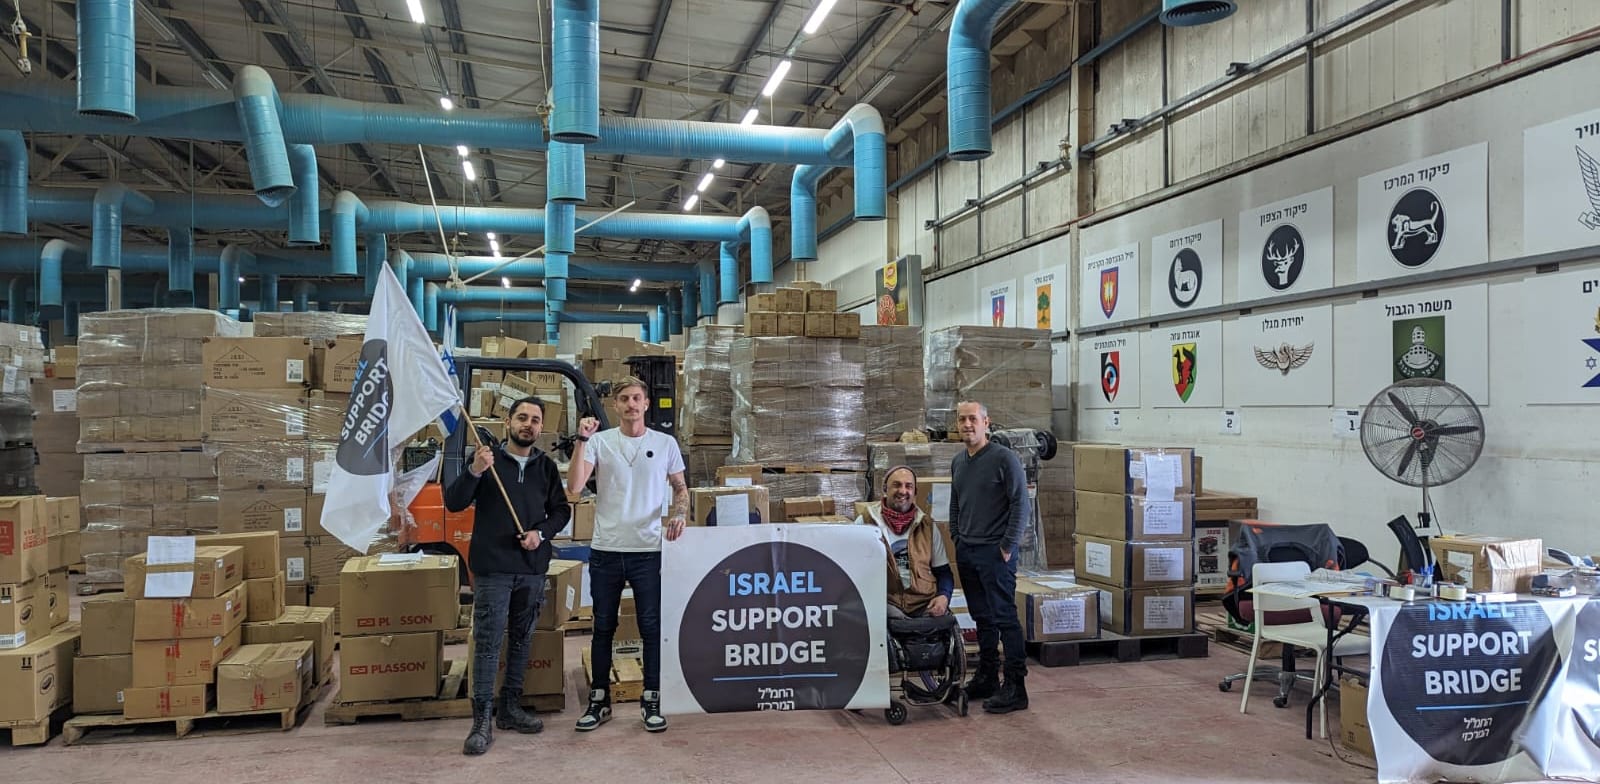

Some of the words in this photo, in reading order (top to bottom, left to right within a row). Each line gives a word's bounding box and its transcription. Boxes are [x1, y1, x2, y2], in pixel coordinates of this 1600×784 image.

[1575, 121, 1600, 139] וויר
[1417, 163, 1450, 182] פיקוד
[1383, 173, 1415, 191] המרכז
[1260, 210, 1282, 227] הצפון
[1283, 203, 1307, 218] פיקוד
[1384, 304, 1415, 317] הגבול
[1418, 299, 1452, 313] משמר
[1262, 318, 1279, 333] מגלן
[1280, 316, 1304, 328] יחידת
[341, 358, 389, 440] SUPPORT
[1226, 419, 1233, 428] 2
[1349, 420, 1355, 431] 1
[729, 571, 822, 596] ISRAEL
[378, 615, 433, 627] PLSSON
[711, 604, 838, 632] SUPPORT
[1412, 631, 1532, 658] SUPPORT
[724, 640, 826, 667] BRIDGE
[371, 661, 426, 674] PLASSON
[498, 659, 551, 671] PSON
[1424, 668, 1522, 695] BRIDGE
